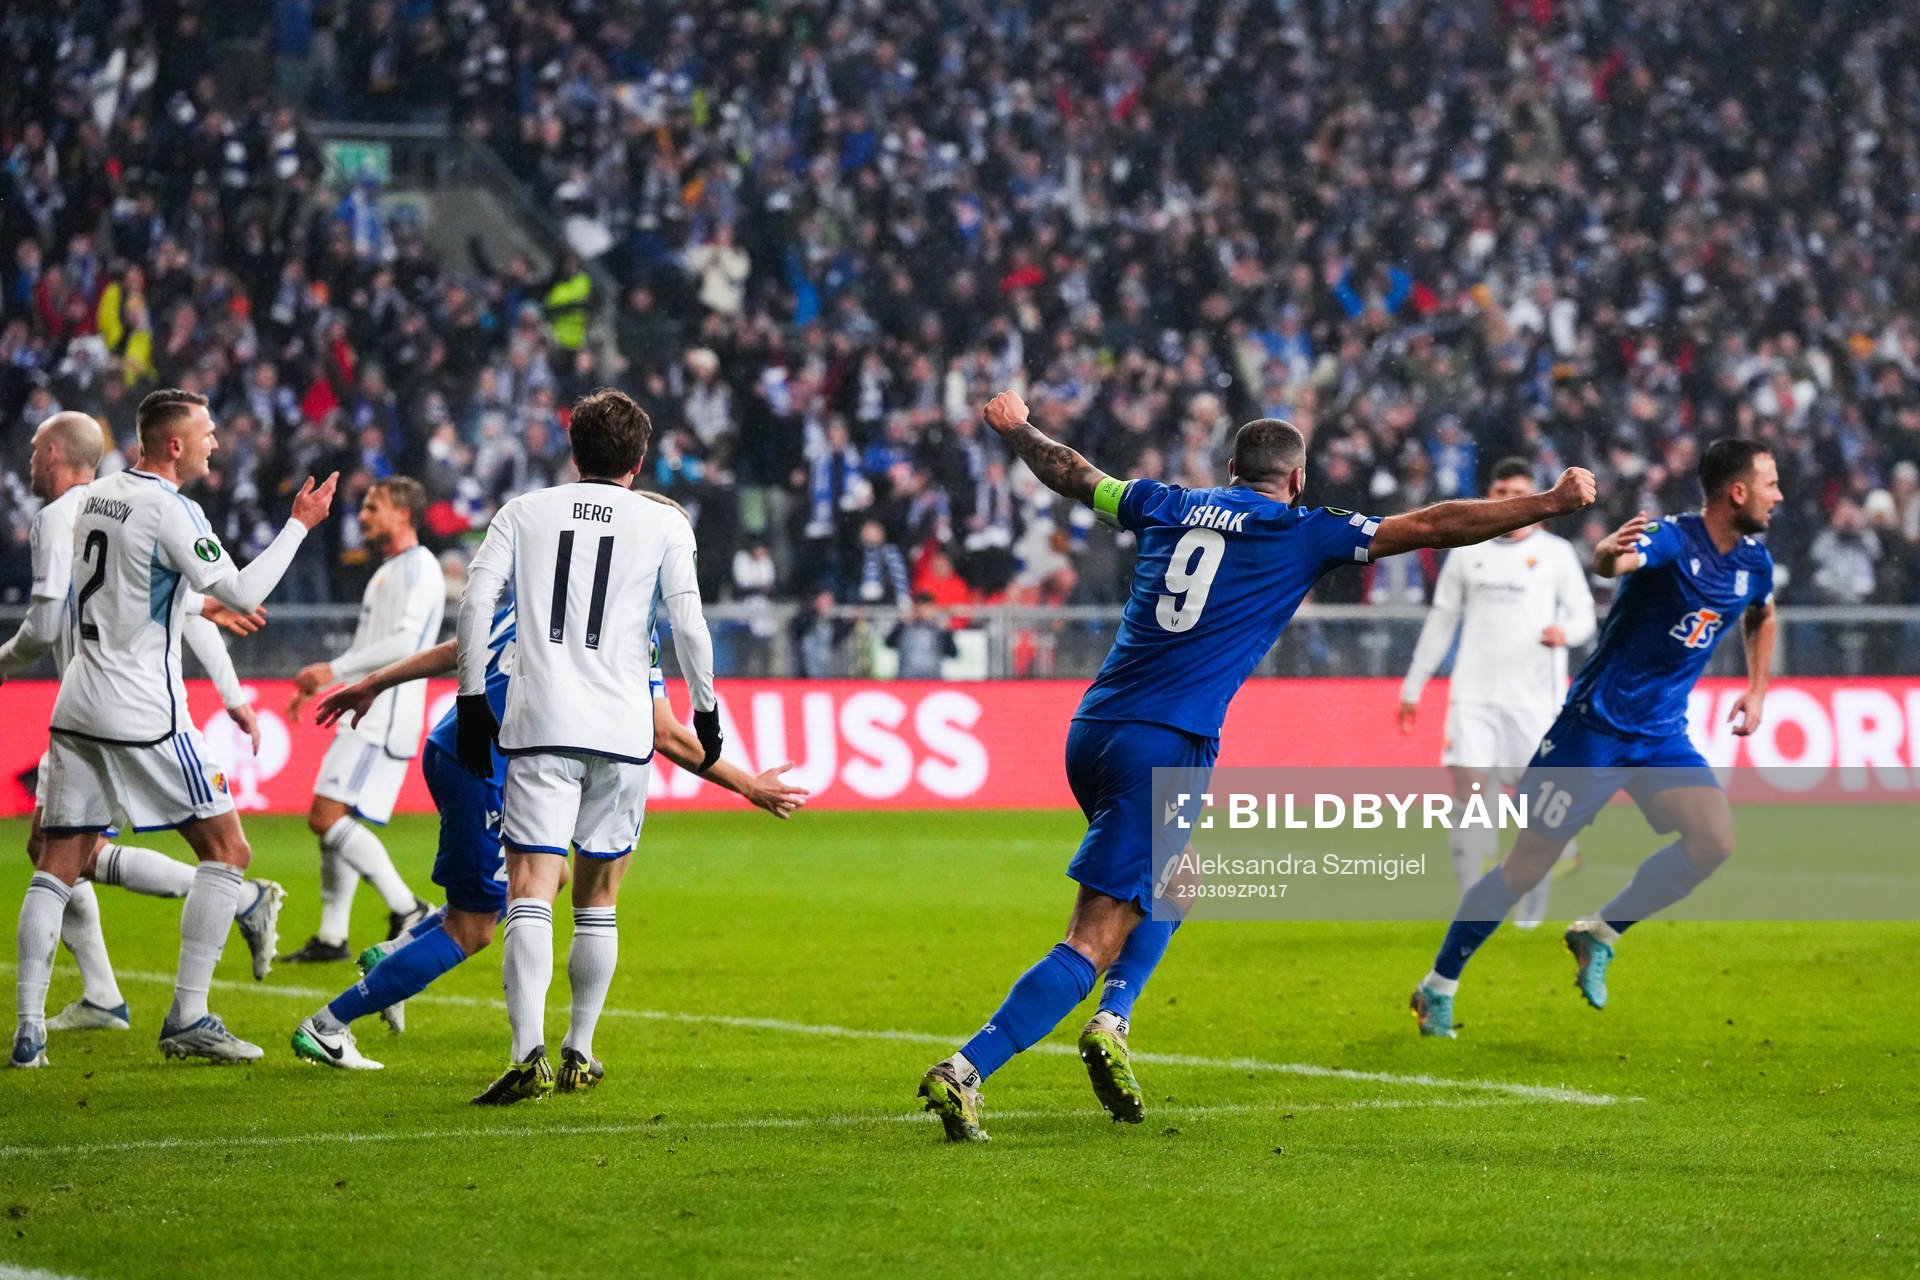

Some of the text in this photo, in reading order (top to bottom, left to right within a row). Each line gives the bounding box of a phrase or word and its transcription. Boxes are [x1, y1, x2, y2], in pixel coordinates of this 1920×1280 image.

[572, 502, 613, 523] BERG
[1181, 505, 1249, 533] ISHAK
[78, 529, 108, 640] 2
[549, 530, 615, 650] 11
[1155, 528, 1225, 633] 9
[1669, 608, 1723, 648] STS
[645, 689, 990, 800] AUSS
[1687, 686, 1920, 793] WOR
[1532, 781, 1572, 828] 16
[1154, 855, 1180, 899] 9
